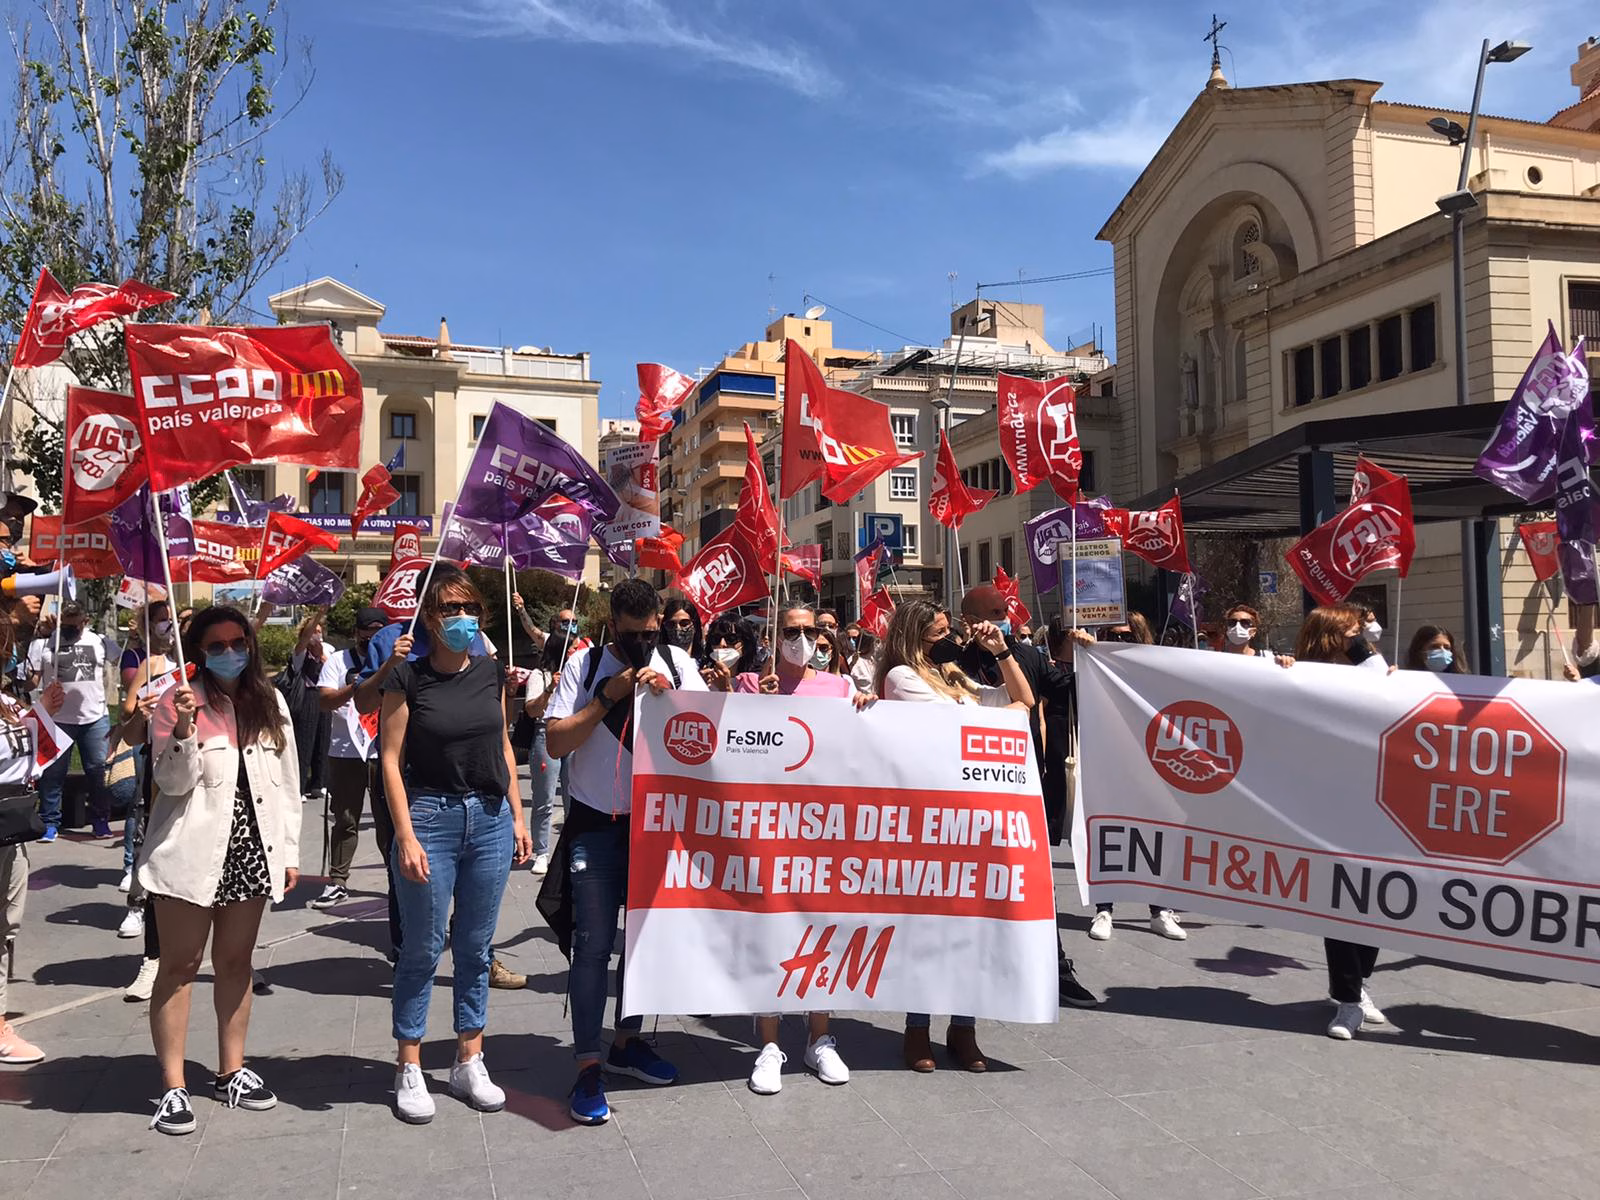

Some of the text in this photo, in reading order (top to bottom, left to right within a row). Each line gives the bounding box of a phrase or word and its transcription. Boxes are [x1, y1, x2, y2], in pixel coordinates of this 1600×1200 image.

[141, 368, 282, 408] CCOO
[79, 422, 135, 450] UGT
[148, 410, 193, 436] país
[483, 471, 516, 490] país
[324, 518, 336, 527] NO
[362, 519, 369, 527] A
[370, 519, 391, 528] OTRO
[612, 524, 630, 534] LOW
[631, 520, 652, 530] COST
[874, 518, 895, 543] P
[36, 533, 107, 550] CCOO
[194, 538, 234, 560] COO
[670, 719, 711, 745] UGT
[726, 729, 784, 747] FeSMC
[1155, 713, 1232, 754] UGT
[966, 734, 1027, 757] CCOO
[1412, 721, 1534, 778] STOP
[962, 764, 1027, 785] servicios
[643, 792, 1037, 852] EN DEFENSA DEL EMPLEO,
[1426, 783, 1512, 839] ERE
[664, 849, 1026, 902] NO AL ERE SALVAJE DE
[1098, 825, 1163, 877] EN
[1181, 834, 1310, 903] H&M
[1330, 862, 1418, 922] NO
[776, 924, 896, 1000] H&M
